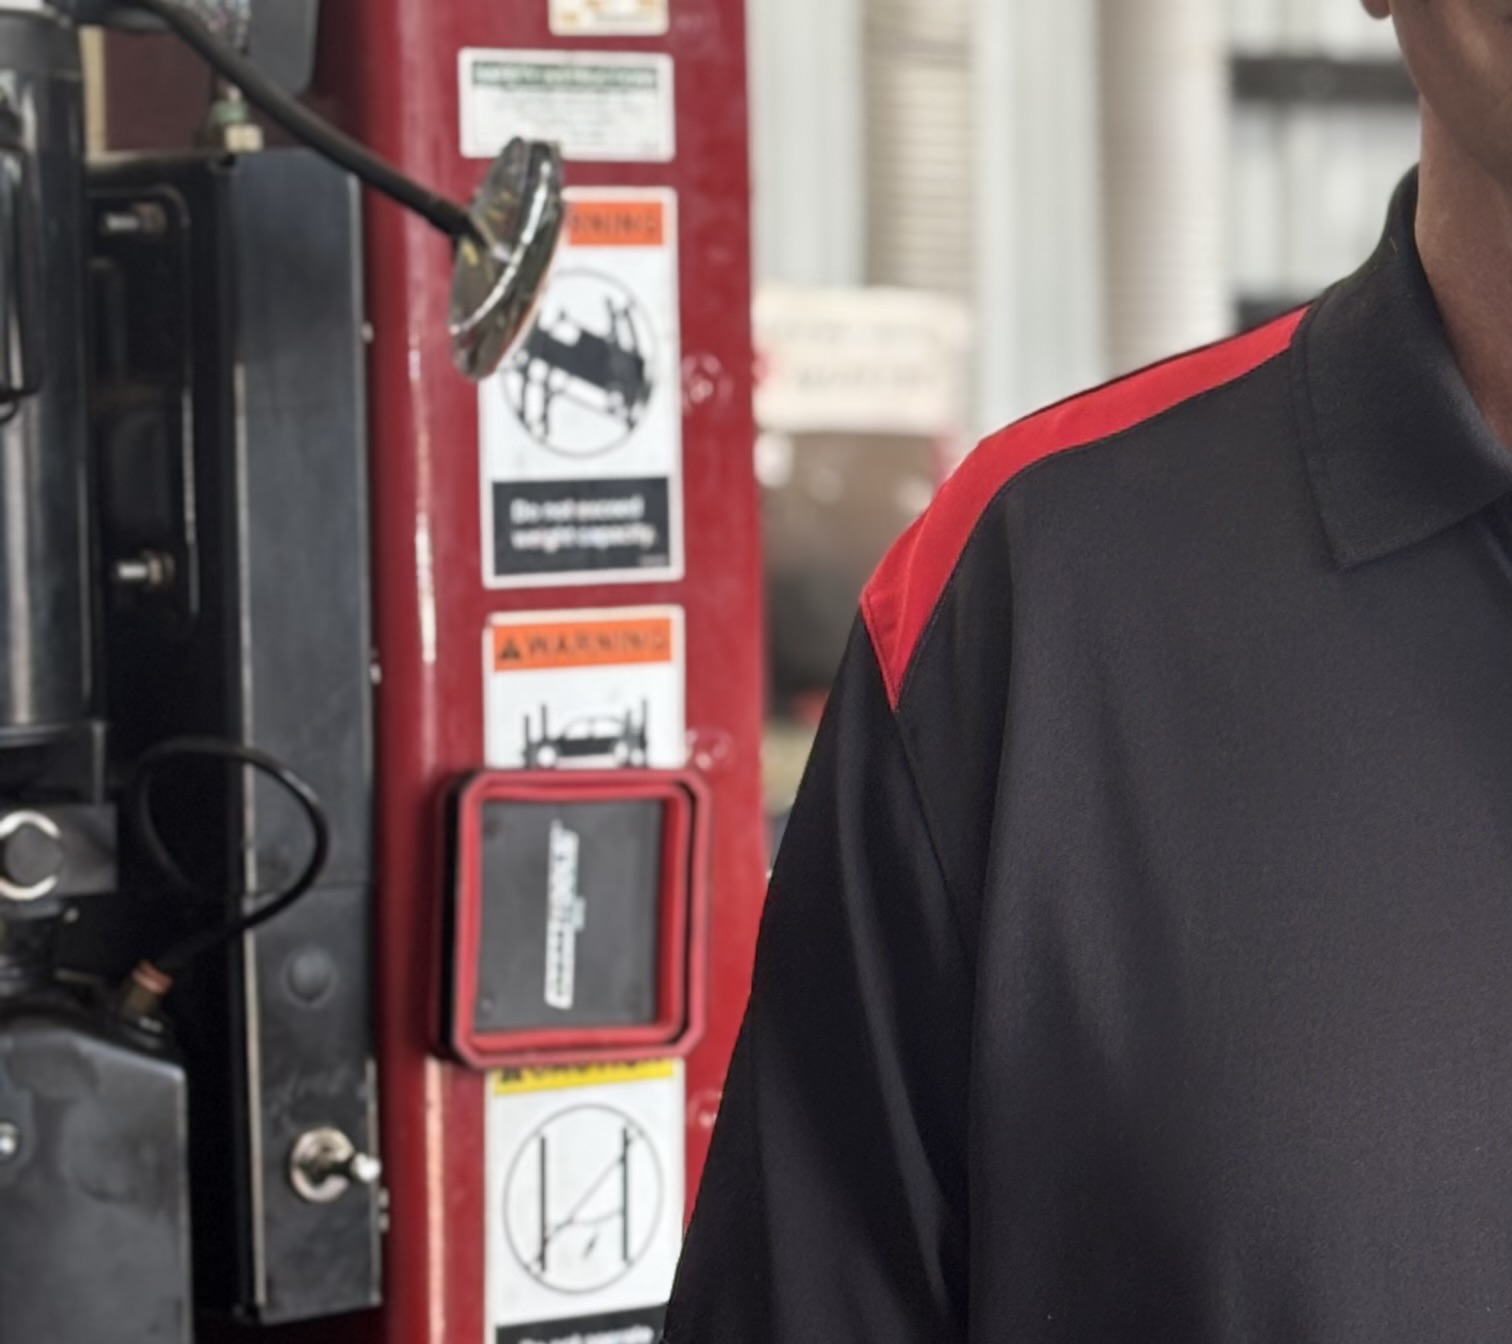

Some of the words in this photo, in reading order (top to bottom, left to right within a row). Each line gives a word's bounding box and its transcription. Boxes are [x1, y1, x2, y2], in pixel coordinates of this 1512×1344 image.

[510, 497, 541, 524] Do
[543, 498, 575, 523] not
[528, 626, 669, 655] WARNING
